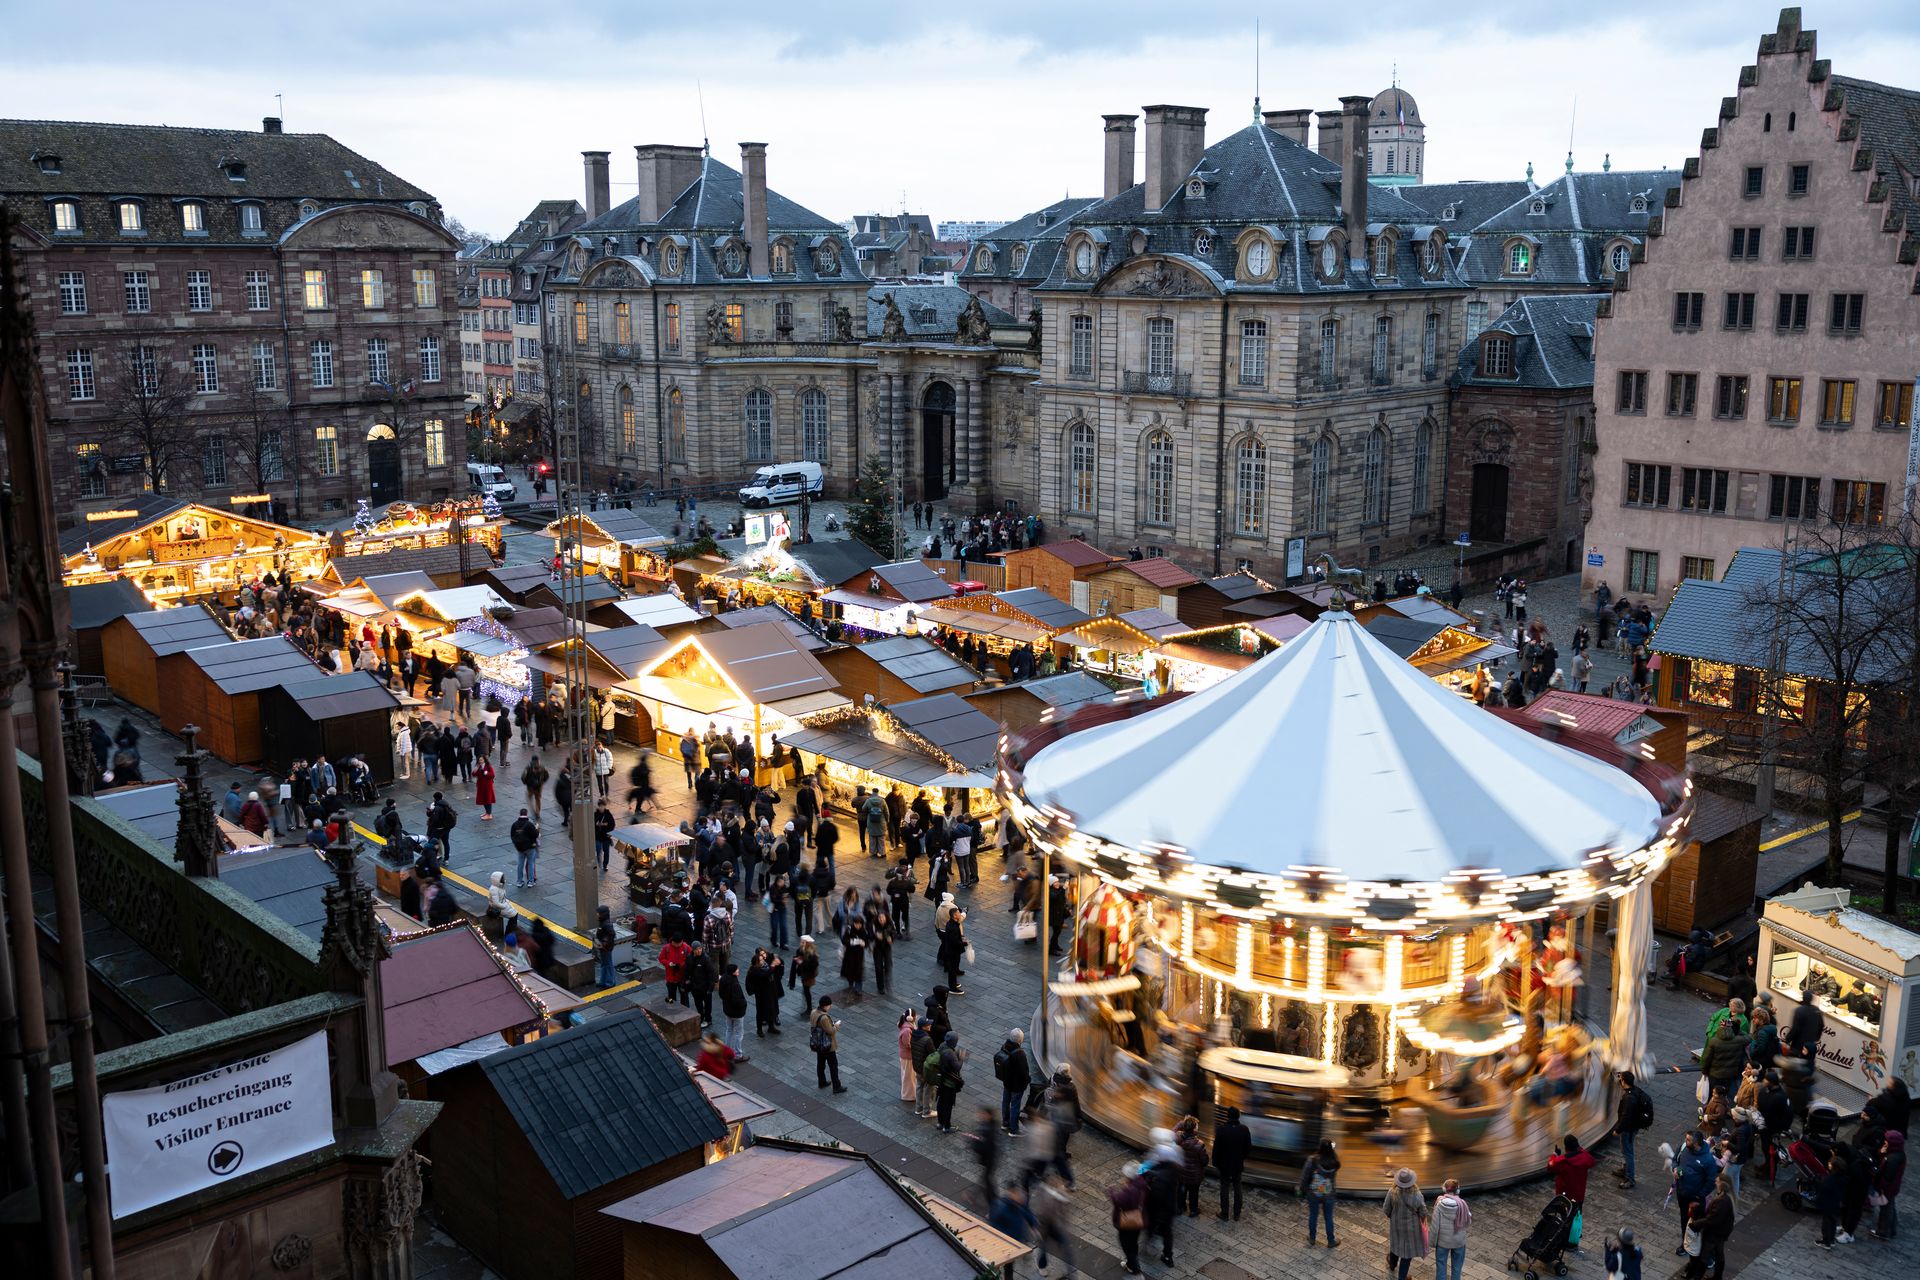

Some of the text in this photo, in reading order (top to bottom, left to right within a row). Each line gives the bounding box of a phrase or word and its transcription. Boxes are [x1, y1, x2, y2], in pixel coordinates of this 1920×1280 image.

[147, 1073, 292, 1128] Besuchereingang
[155, 1100, 292, 1151] Visitor Entrance
